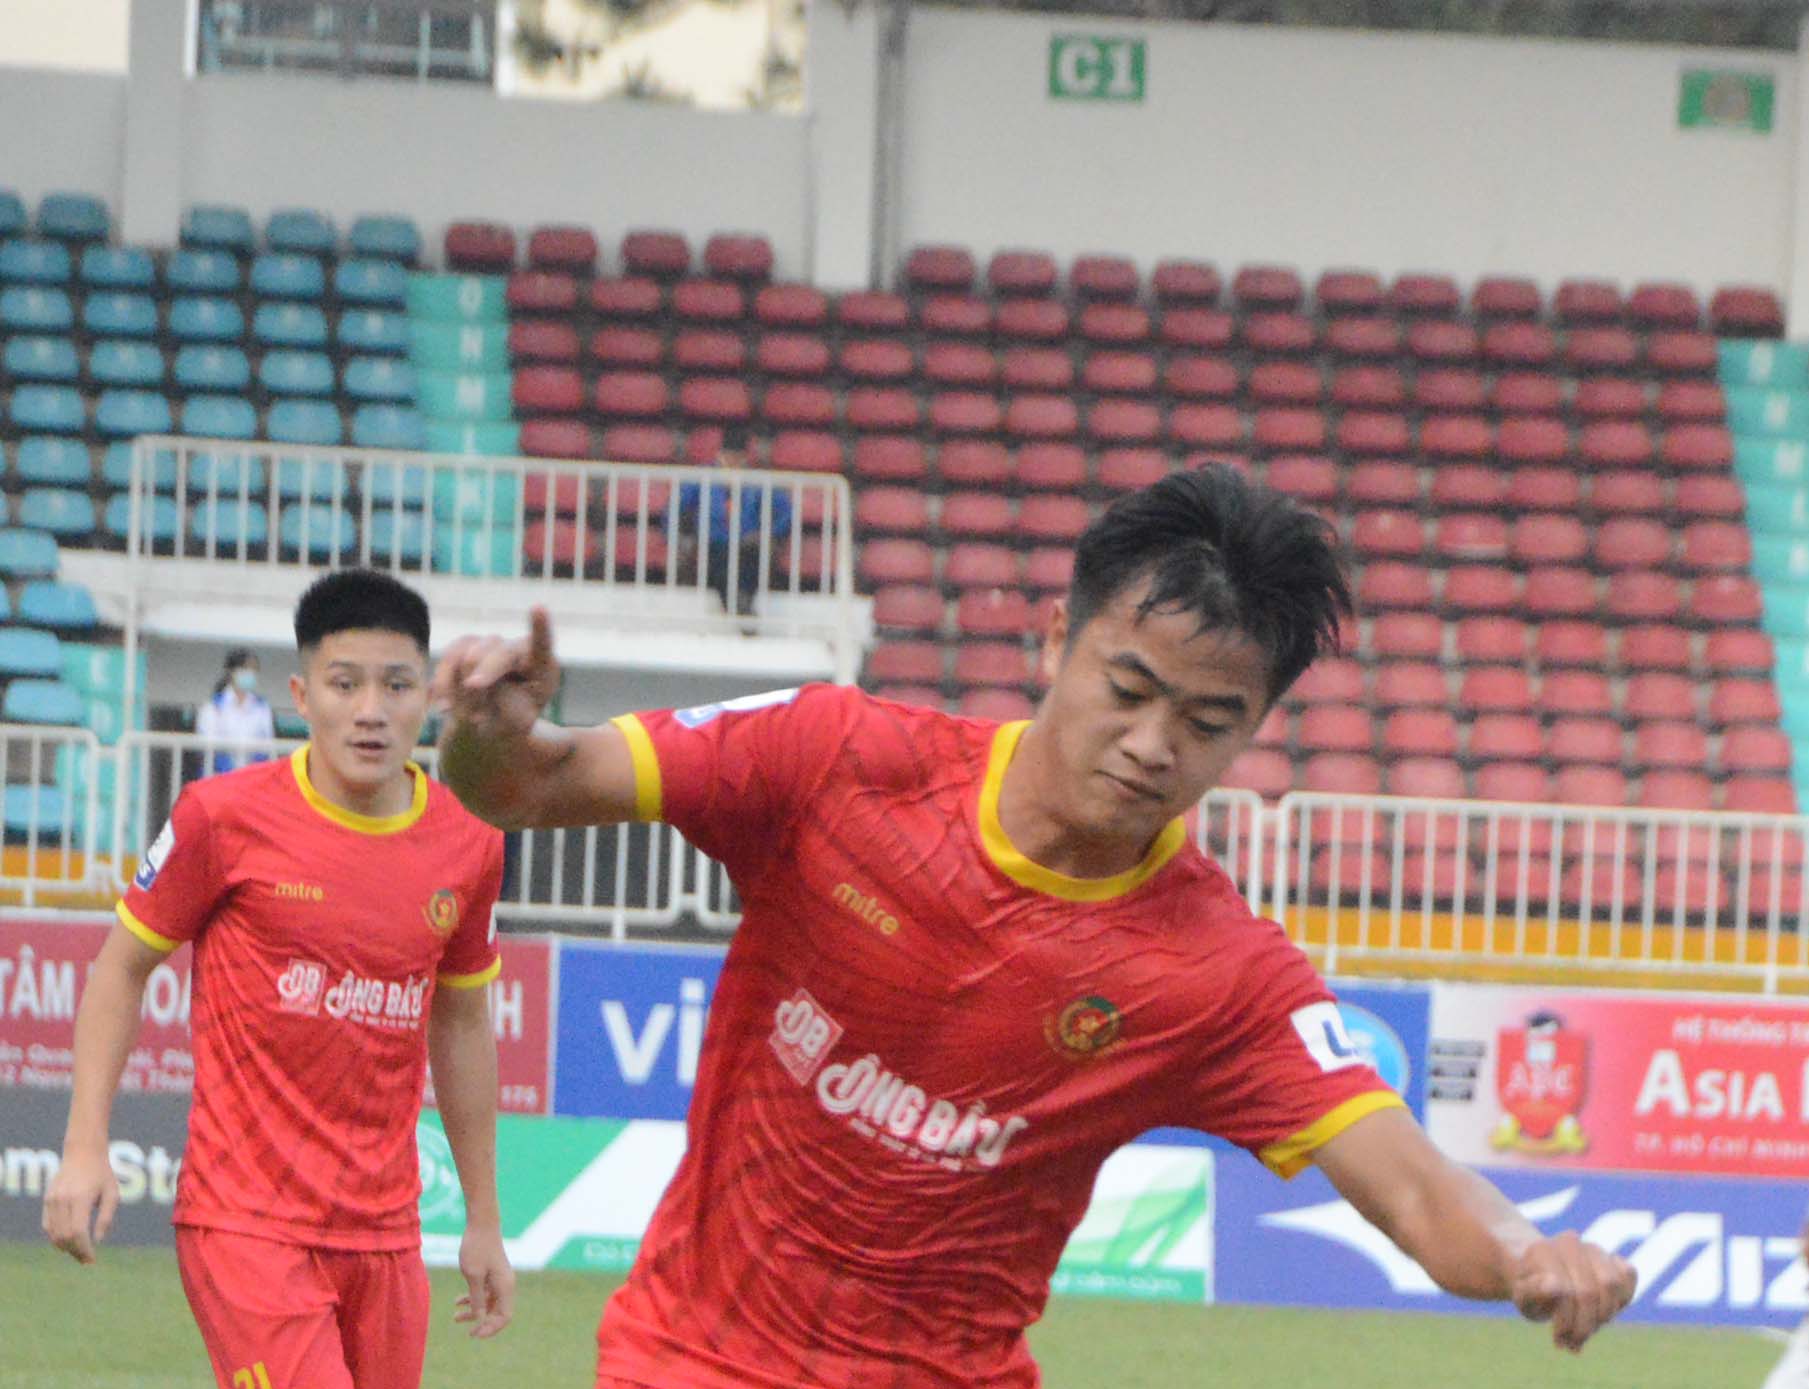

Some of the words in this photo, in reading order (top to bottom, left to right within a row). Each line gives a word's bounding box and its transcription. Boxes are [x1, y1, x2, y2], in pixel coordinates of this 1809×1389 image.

[1060, 42, 1135, 95] C1
[275, 881, 325, 901] mitre
[832, 882, 899, 936] mitre
